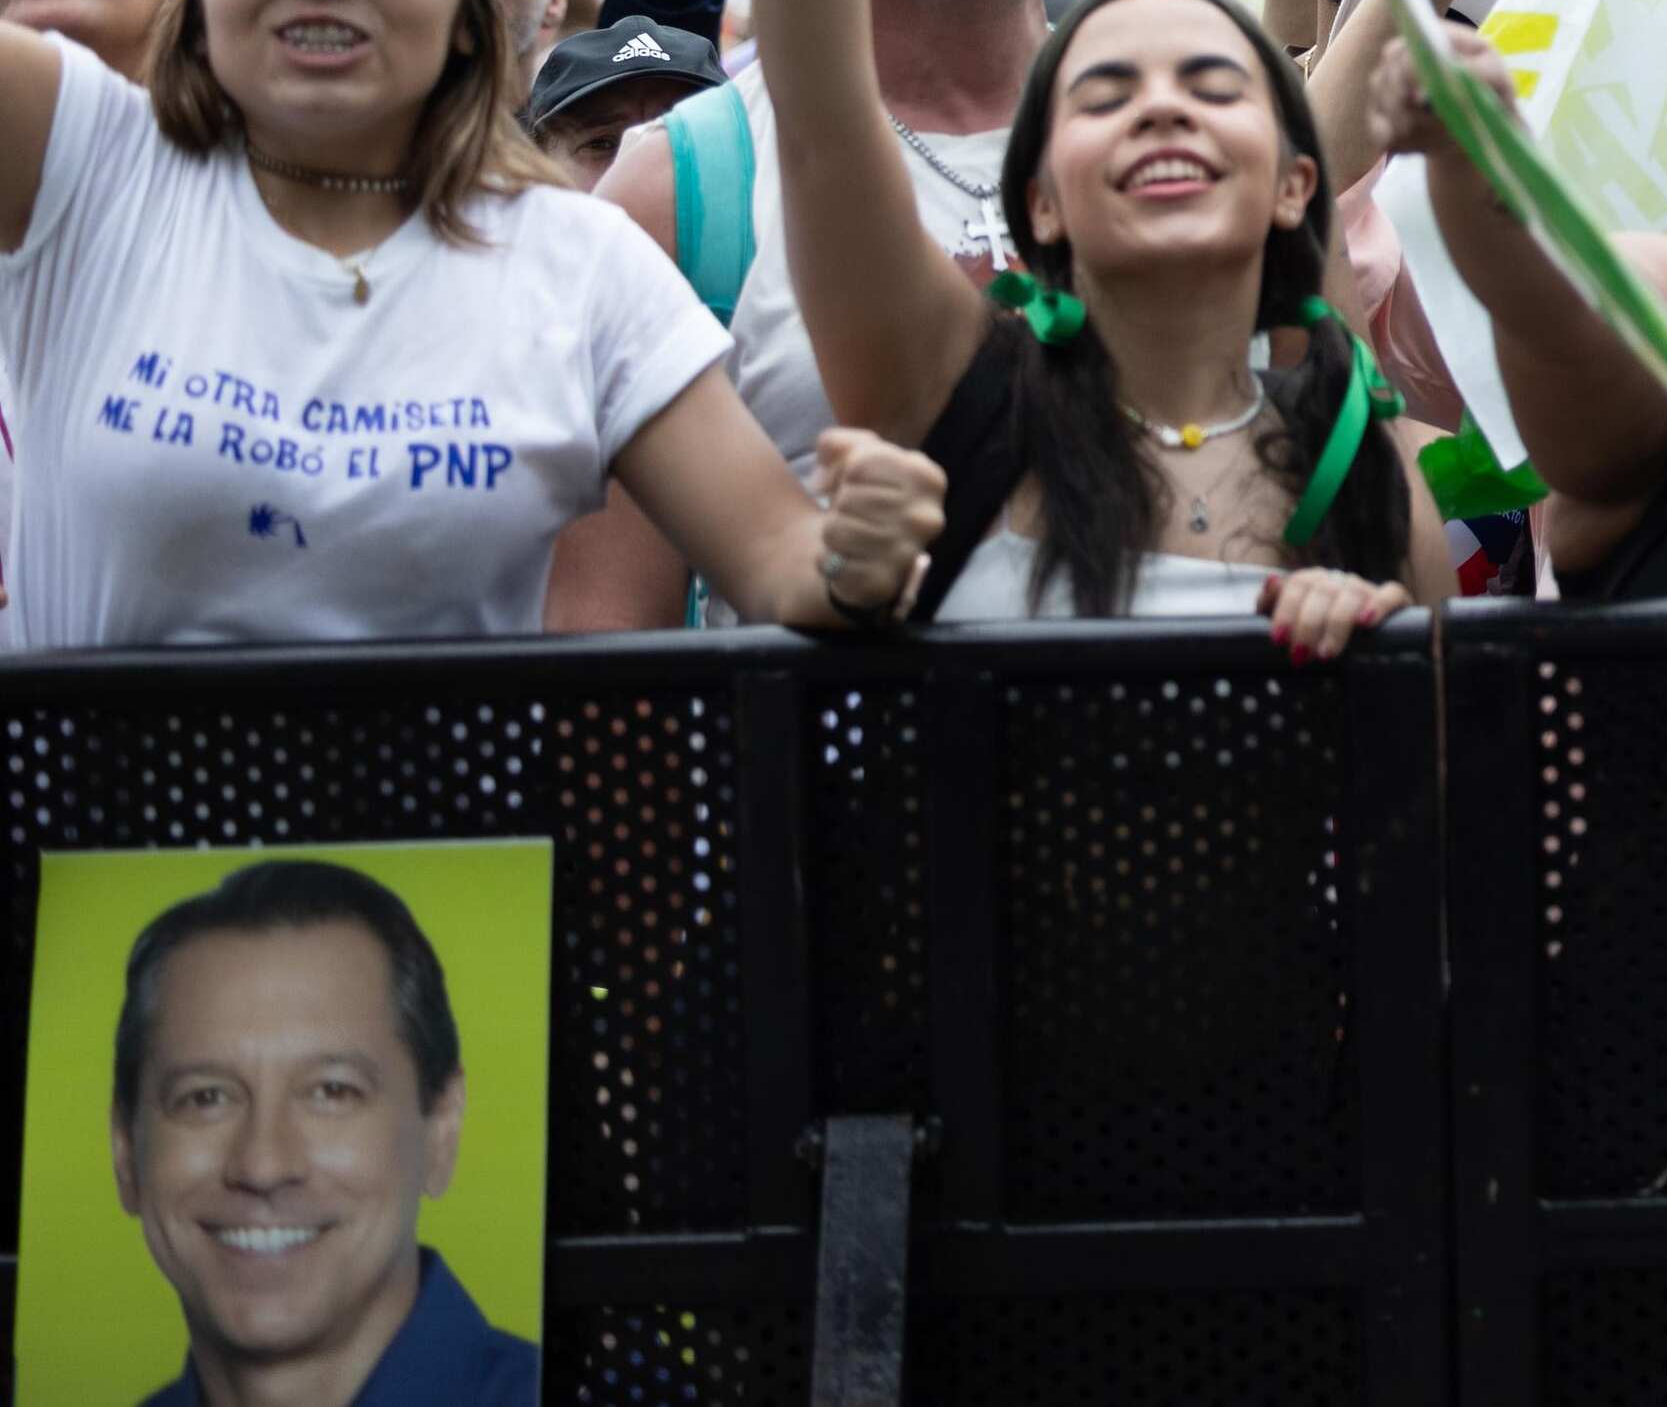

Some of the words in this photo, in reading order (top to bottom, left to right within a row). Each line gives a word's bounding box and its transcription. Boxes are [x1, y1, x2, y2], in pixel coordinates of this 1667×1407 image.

[612, 47, 671, 62] adidas
[98, 394, 142, 433] ME
[152, 407, 194, 446] LA
[408, 443, 512, 490] PNP
